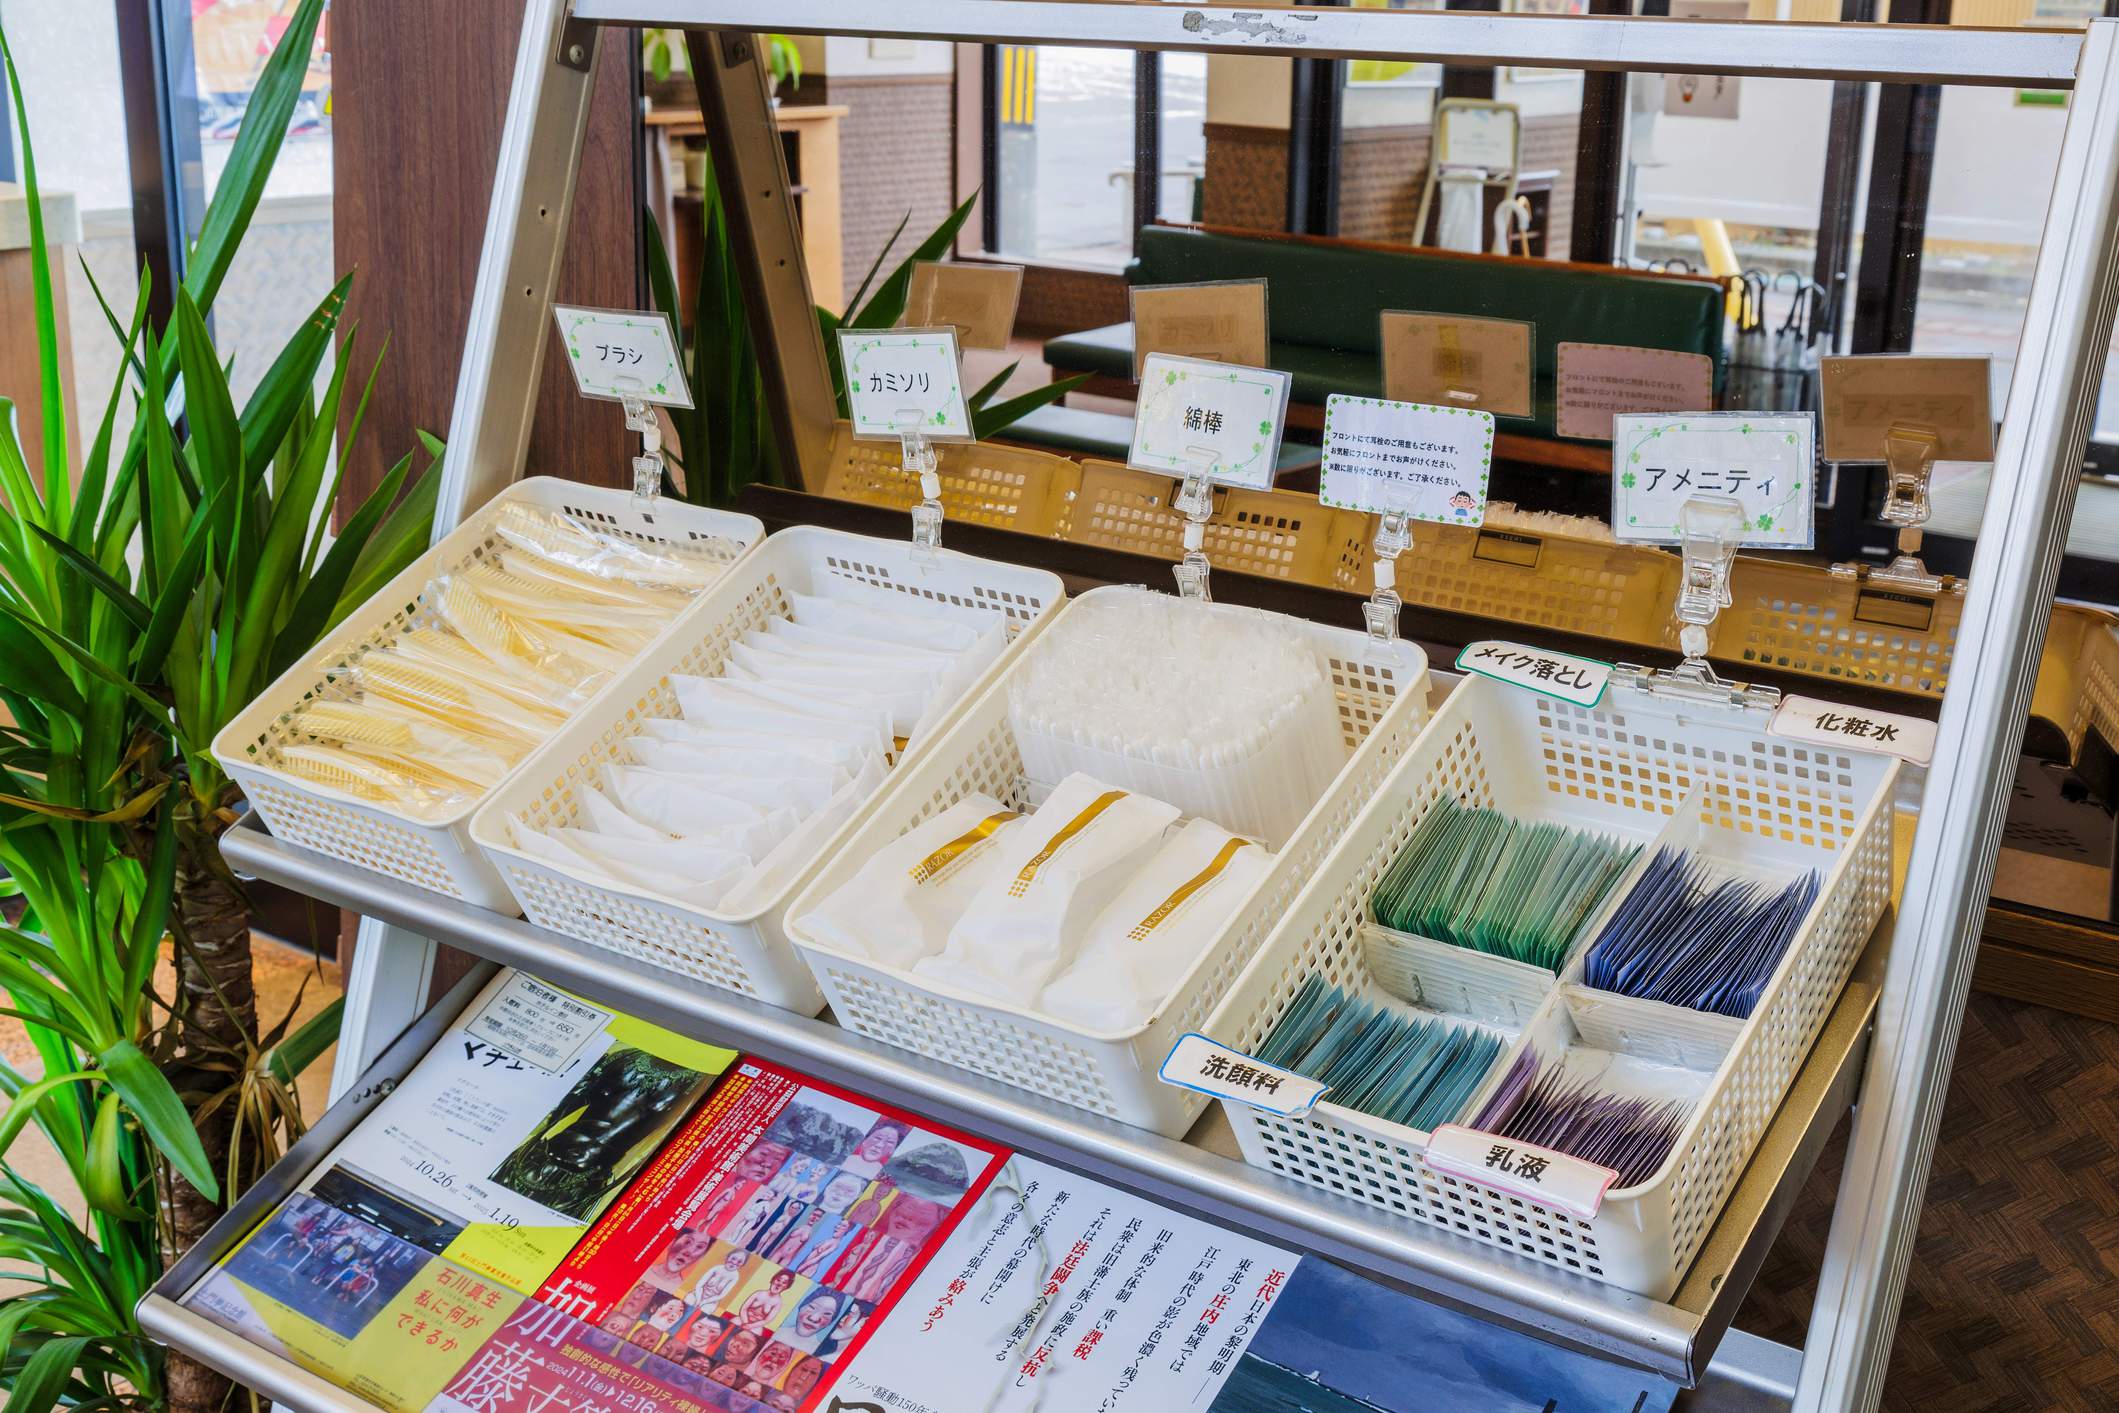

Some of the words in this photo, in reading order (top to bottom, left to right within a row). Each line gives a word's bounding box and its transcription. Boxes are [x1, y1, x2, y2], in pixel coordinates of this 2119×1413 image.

[595, 343, 644, 366] ブラシ
[869, 371, 930, 394] カミソリ
[1183, 405, 1223, 435] 綿棒
[1329, 446, 1458, 471] お気軽にフロントまでお声がけください。
[1331, 431, 1460, 456] フロントにて耳栓のご用意もございます。
[1644, 467, 1776, 496] アメニティ
[1475, 645, 1593, 691] メイク落とし
[1815, 711, 1900, 743] 化粧水
[926, 848, 954, 872] RAZOR
[1023, 850, 1049, 879] RAZOR
[1144, 900, 1176, 927] RAZOR
[1199, 1053, 1288, 1096] 洗顔料
[414, 1160, 457, 1189] 10.26
[1484, 1143, 1551, 1183] 乳液
[488, 1207, 520, 1232] 1.19
[919, 1180, 1041, 1332] 各々の意志と主張が絡みあう
[980, 1189, 1072, 1305] 新たな時代の幕開けに
[1115, 1228, 1174, 1303] 旧来的な体制
[436, 1267, 503, 1310] 石川真生
[995, 1207, 1112, 1362] それは法廷闘争へと発展する
[1015, 1217, 1143, 1388] 民衆は旧藩士族の施政に反抗し
[414, 1289, 484, 1330] 私に何が
[1097, 1245, 1222, 1413] 江戸時代の影が色濃く残ってい
[1169, 1258, 1254, 1374] 東北の庄内地域では
[397, 1312, 459, 1352] できるか
[1071, 1308, 1119, 1361] 重い課税
[546, 1361, 569, 1377] 2024
[847, 1374, 939, 1413] ワッパ騒動150年
